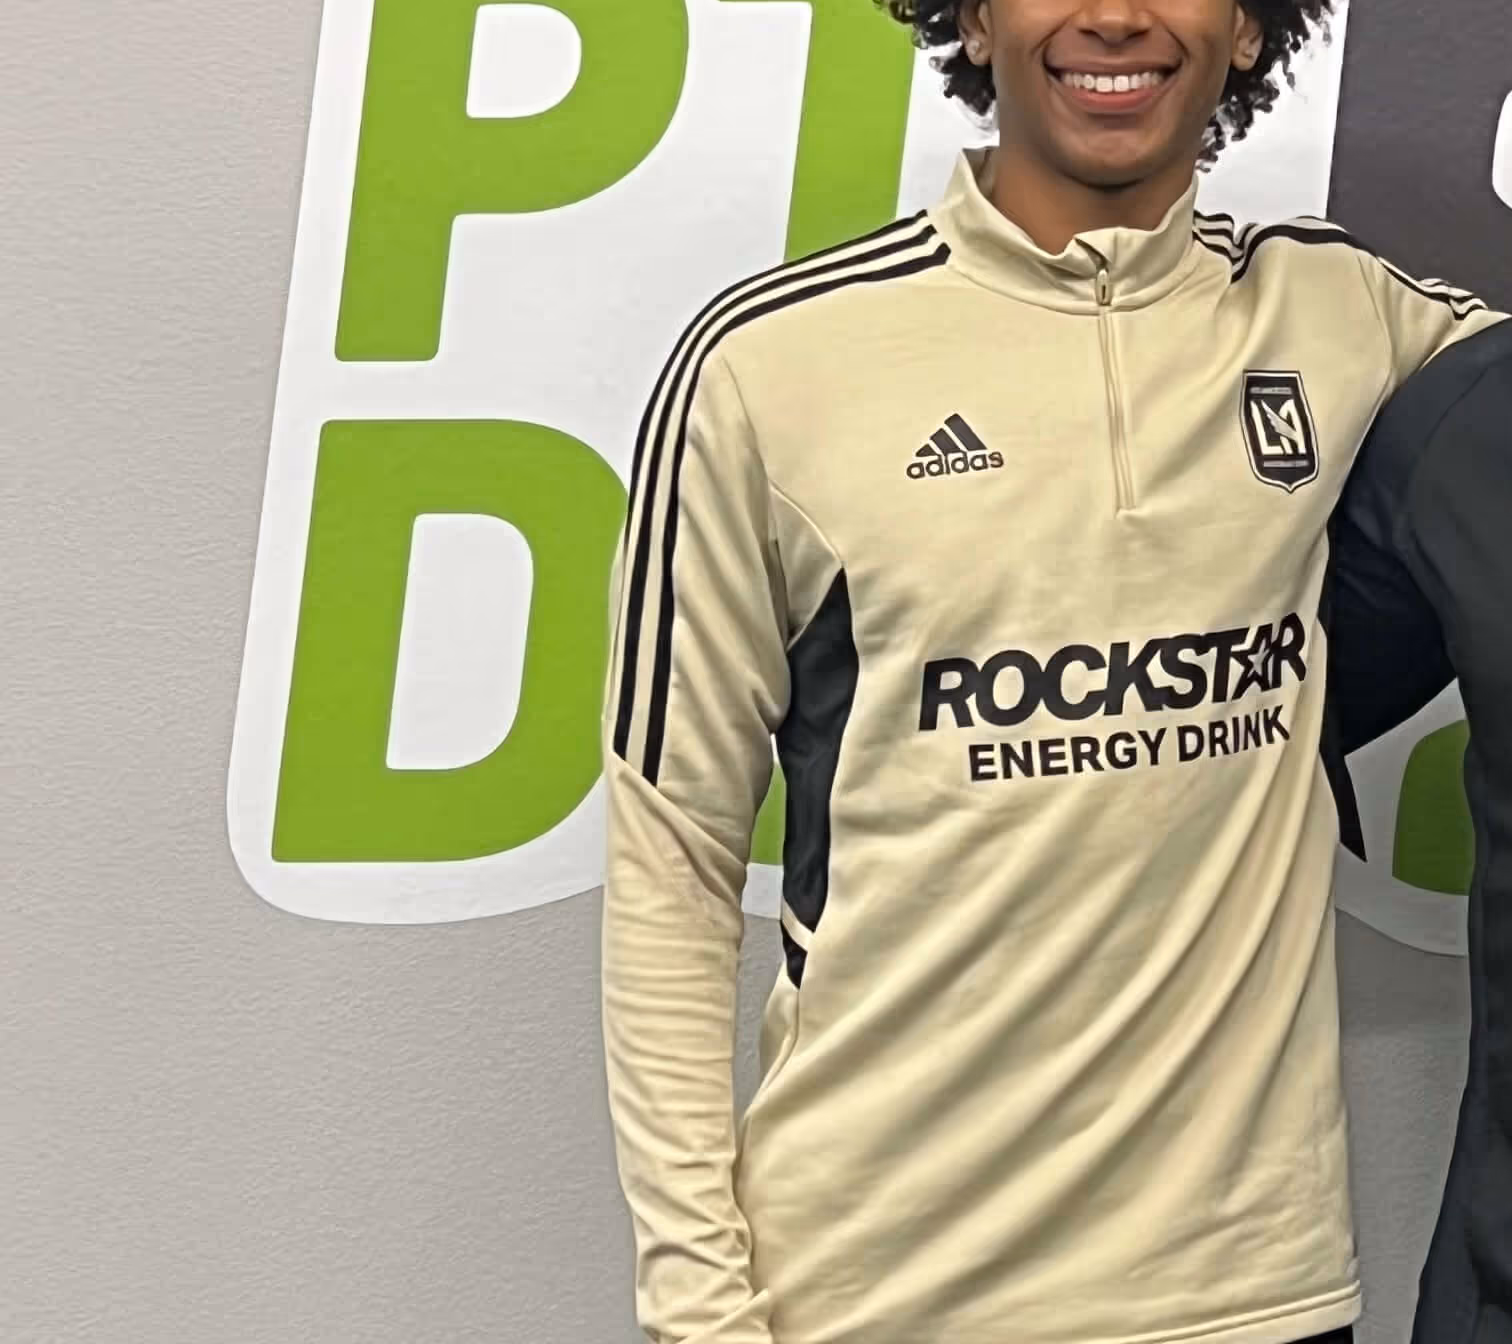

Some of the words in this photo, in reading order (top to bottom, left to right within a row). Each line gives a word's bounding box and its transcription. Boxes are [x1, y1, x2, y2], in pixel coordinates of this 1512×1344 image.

[905, 449, 1005, 481] adidas
[918, 611, 1306, 733] ROCKSTAR
[967, 727, 1168, 783] ENERGY
[1176, 704, 1292, 764] DRINK
